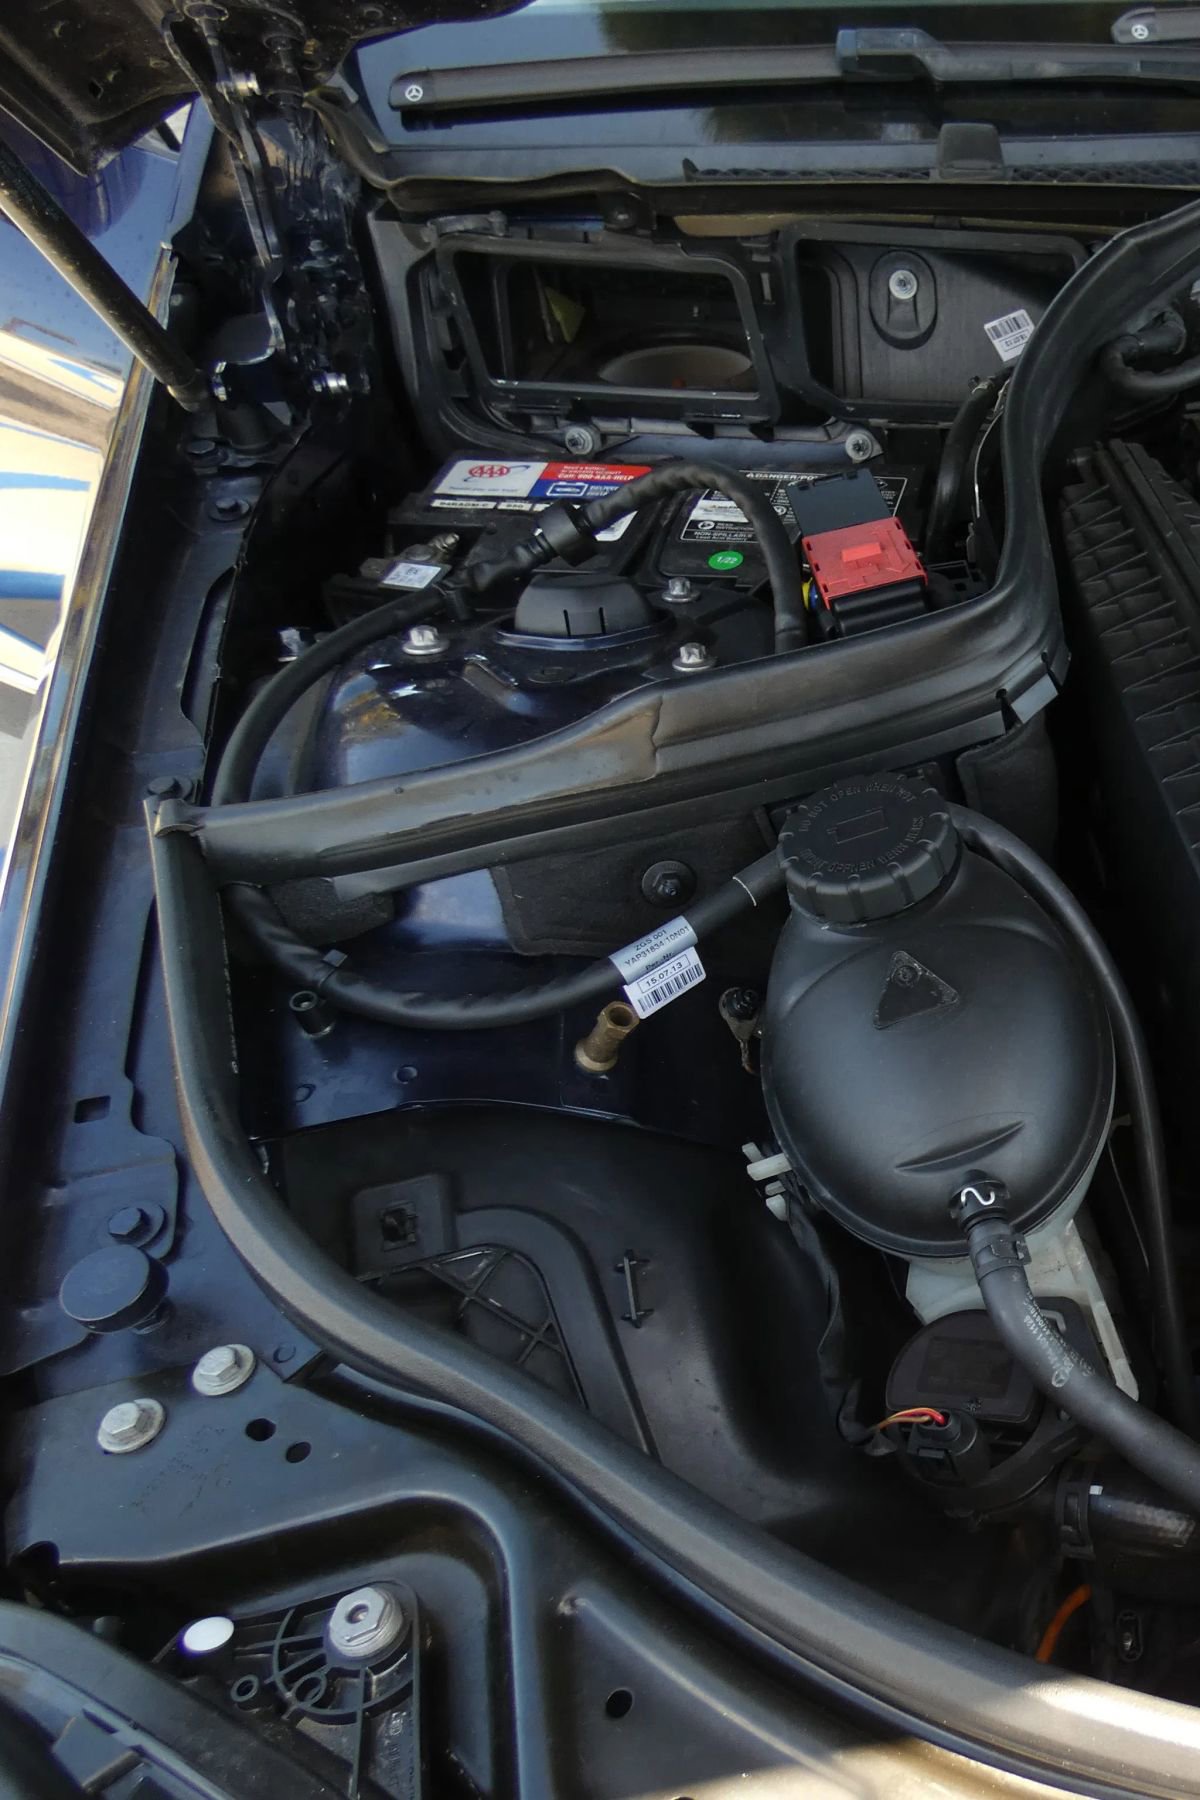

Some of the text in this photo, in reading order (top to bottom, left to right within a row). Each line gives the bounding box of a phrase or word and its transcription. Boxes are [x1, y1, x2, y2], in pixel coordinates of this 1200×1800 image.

[468, 464, 511, 478] AAA
[717, 556, 738, 564] 1/22
[635, 929, 667, 951] ZGS 001
[645, 962, 683, 987] 15.07.13
